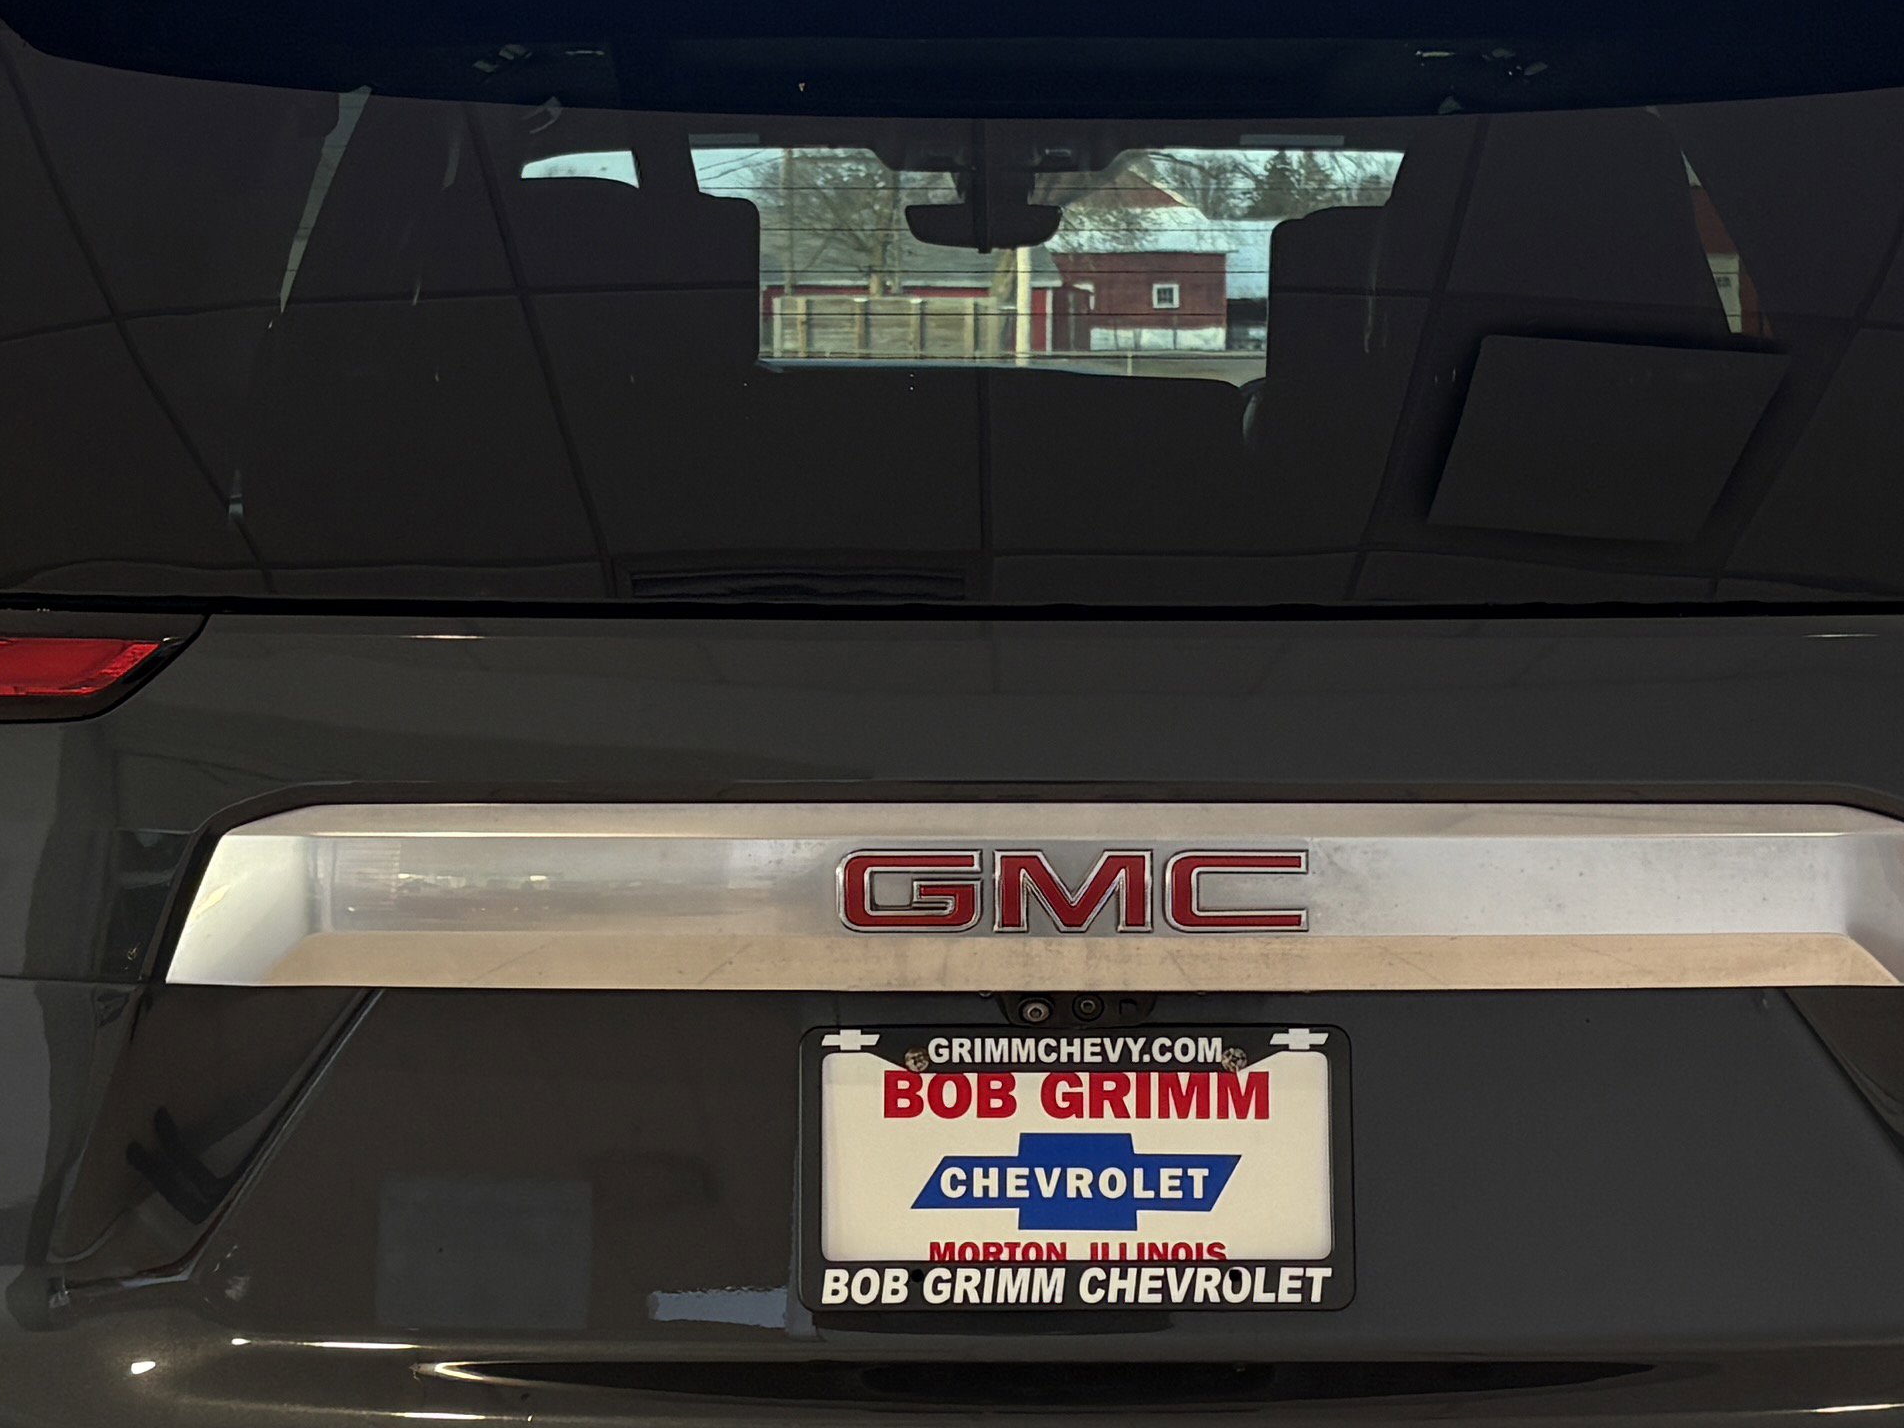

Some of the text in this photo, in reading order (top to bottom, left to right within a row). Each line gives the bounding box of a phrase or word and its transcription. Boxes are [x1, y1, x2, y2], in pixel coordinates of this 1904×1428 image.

[838, 848, 1310, 934] GMC
[927, 1037, 1223, 1064] GRIMMCHEVY.COM
[883, 1071, 1270, 1120] BOB GRIMM
[940, 1167, 1209, 1199] CHEVROLET
[821, 1267, 1332, 1304] BOB GRIMM CHEVROLET
